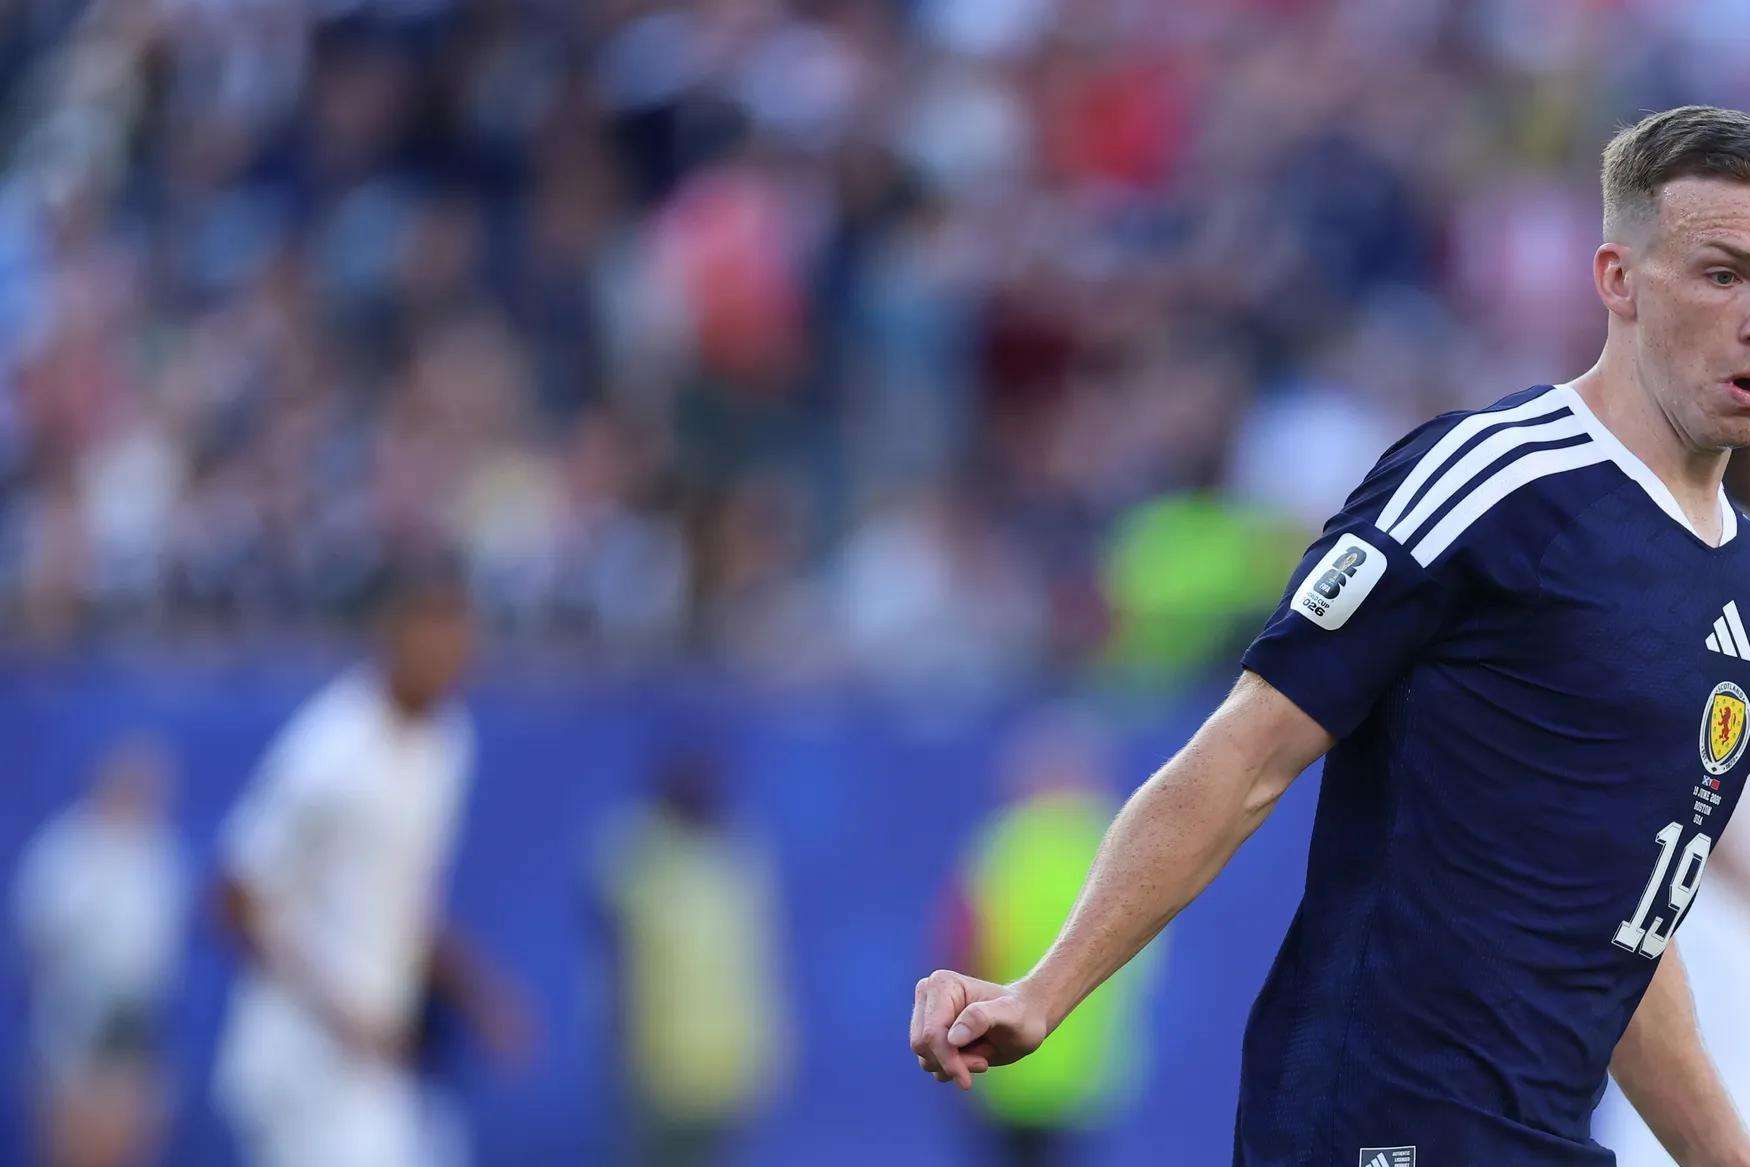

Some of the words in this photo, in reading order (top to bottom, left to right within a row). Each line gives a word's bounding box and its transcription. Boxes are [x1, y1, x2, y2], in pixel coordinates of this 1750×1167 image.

[1317, 598, 1330, 609] CUP
[1717, 683, 1744, 699] SCOTLAND
[1611, 820, 1712, 960] 19
